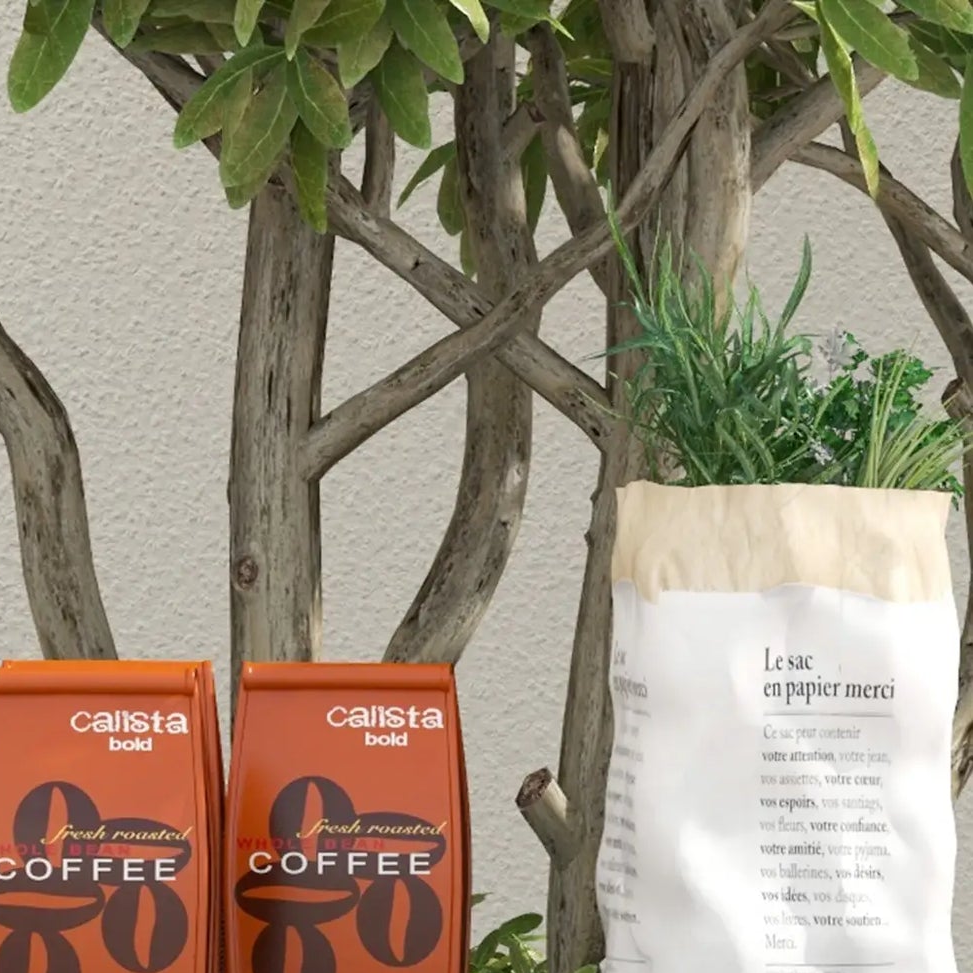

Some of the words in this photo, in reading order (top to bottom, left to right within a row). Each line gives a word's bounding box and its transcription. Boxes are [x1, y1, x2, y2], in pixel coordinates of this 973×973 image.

[764, 647, 784, 671] Le
[787, 654, 814, 671] sac
[763, 680, 782, 698] en
[785, 675, 842, 705] papier
[844, 678, 895, 699] merci
[365, 732, 408, 747] bold
[763, 723, 778, 740] Ce
[779, 727, 794, 740] sac
[795, 727, 817, 744] peut
[818, 725, 862, 740] contenir
[108, 736, 153, 751] bold
[761, 751, 788, 762] votre
[789, 748, 837, 762] attention,
[838, 751, 865, 762] votre
[760, 774, 778, 786] vos
[824, 774, 853, 786] votre
[759, 797, 778, 808] vos
[821, 798, 840, 808] vos
[296, 818, 362, 839] fresh
[366, 820, 449, 836] roasted
[759, 821, 776, 832] vos
[809, 821, 839, 832] votre
[39, 824, 108, 845] fresh
[112, 825, 194, 842] roasted
[69, 844, 132, 856] BEAN
[237, 838, 313, 850] WHOLE
[324, 838, 385, 850] BEAN
[760, 843, 787, 856] votre
[827, 845, 853, 856] votre
[248, 851, 431, 875] COFFEE
[760, 867, 777, 879] vos
[835, 868, 852, 879] vos
[761, 891, 779, 901] vos
[813, 891, 832, 902] vos
[813, 915, 844, 927] votre
